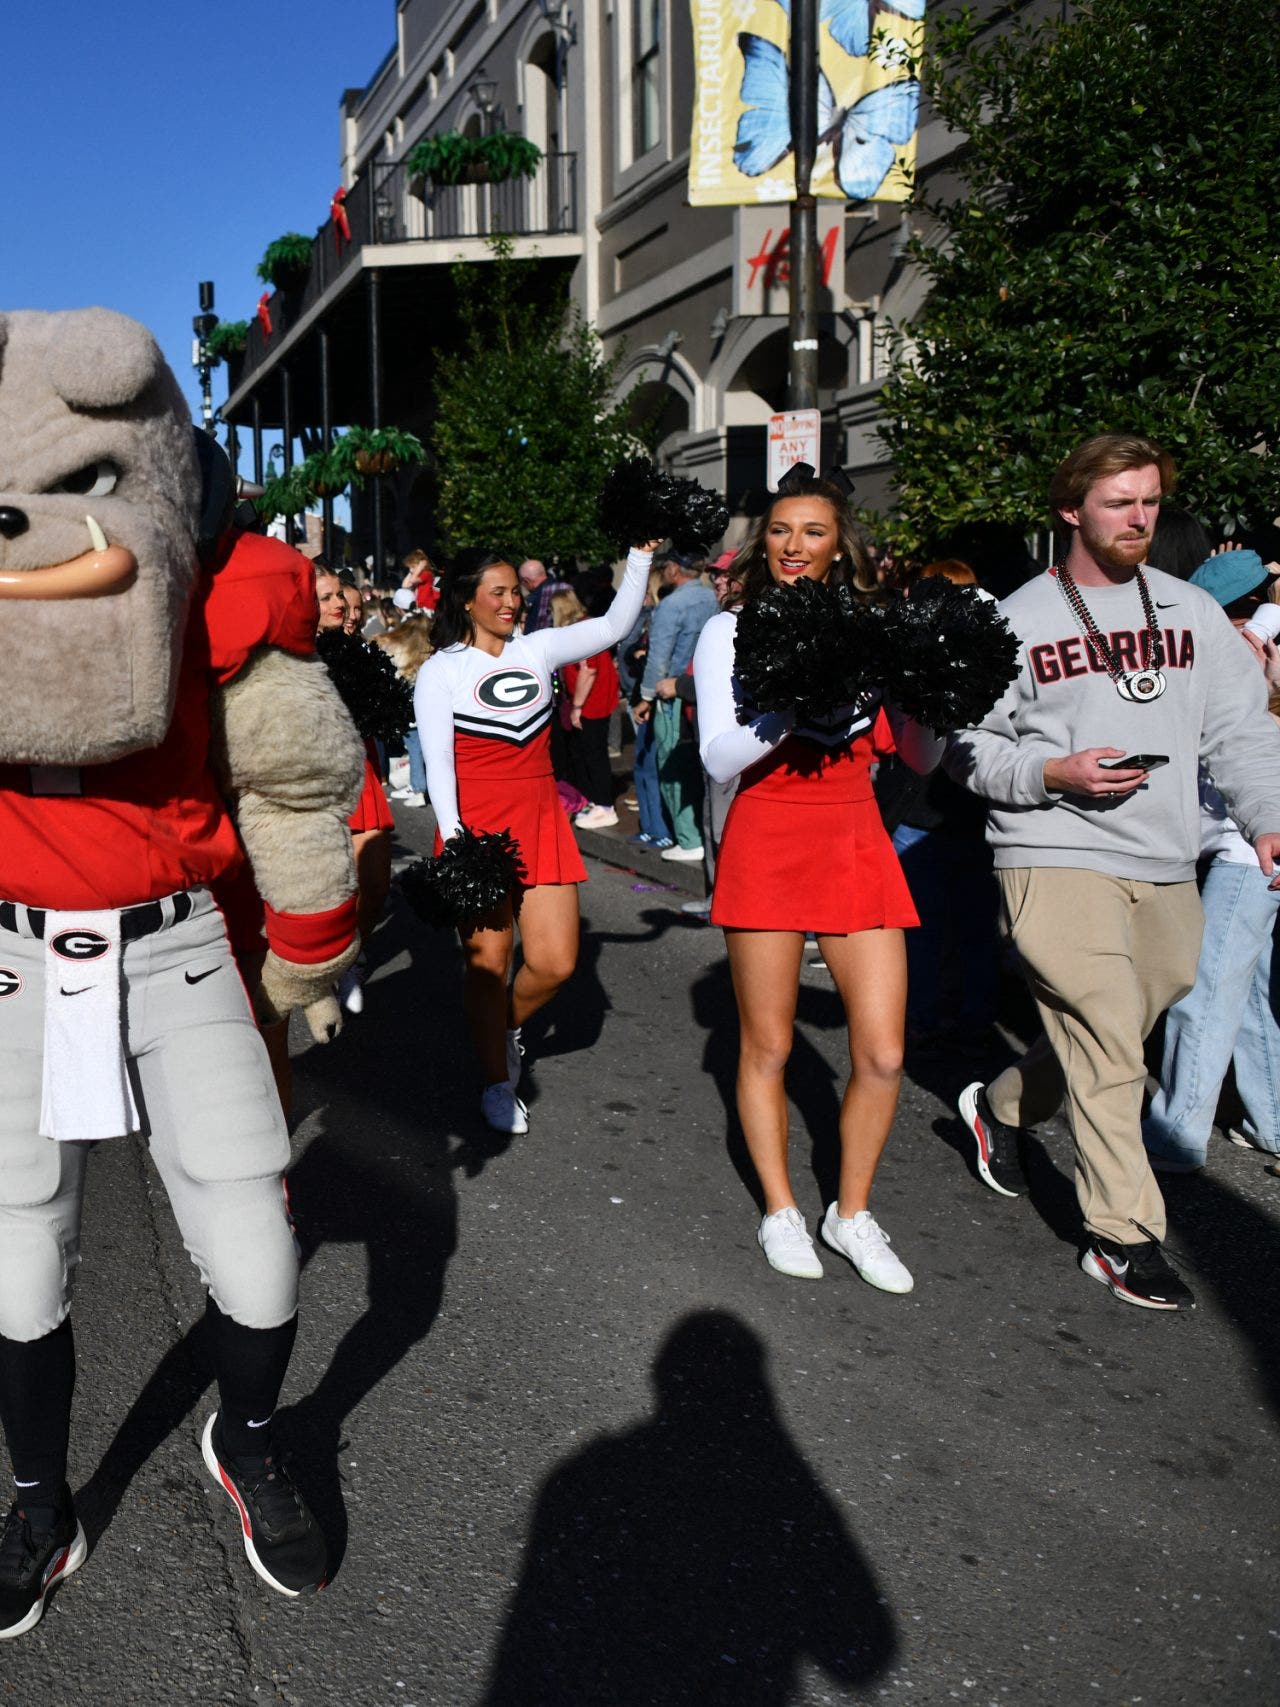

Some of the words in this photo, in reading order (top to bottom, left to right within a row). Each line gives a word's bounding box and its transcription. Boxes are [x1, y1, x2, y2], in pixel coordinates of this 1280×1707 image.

[780, 441, 808, 454] ANY
[477, 669, 541, 709] G
[52, 931, 110, 960] G
